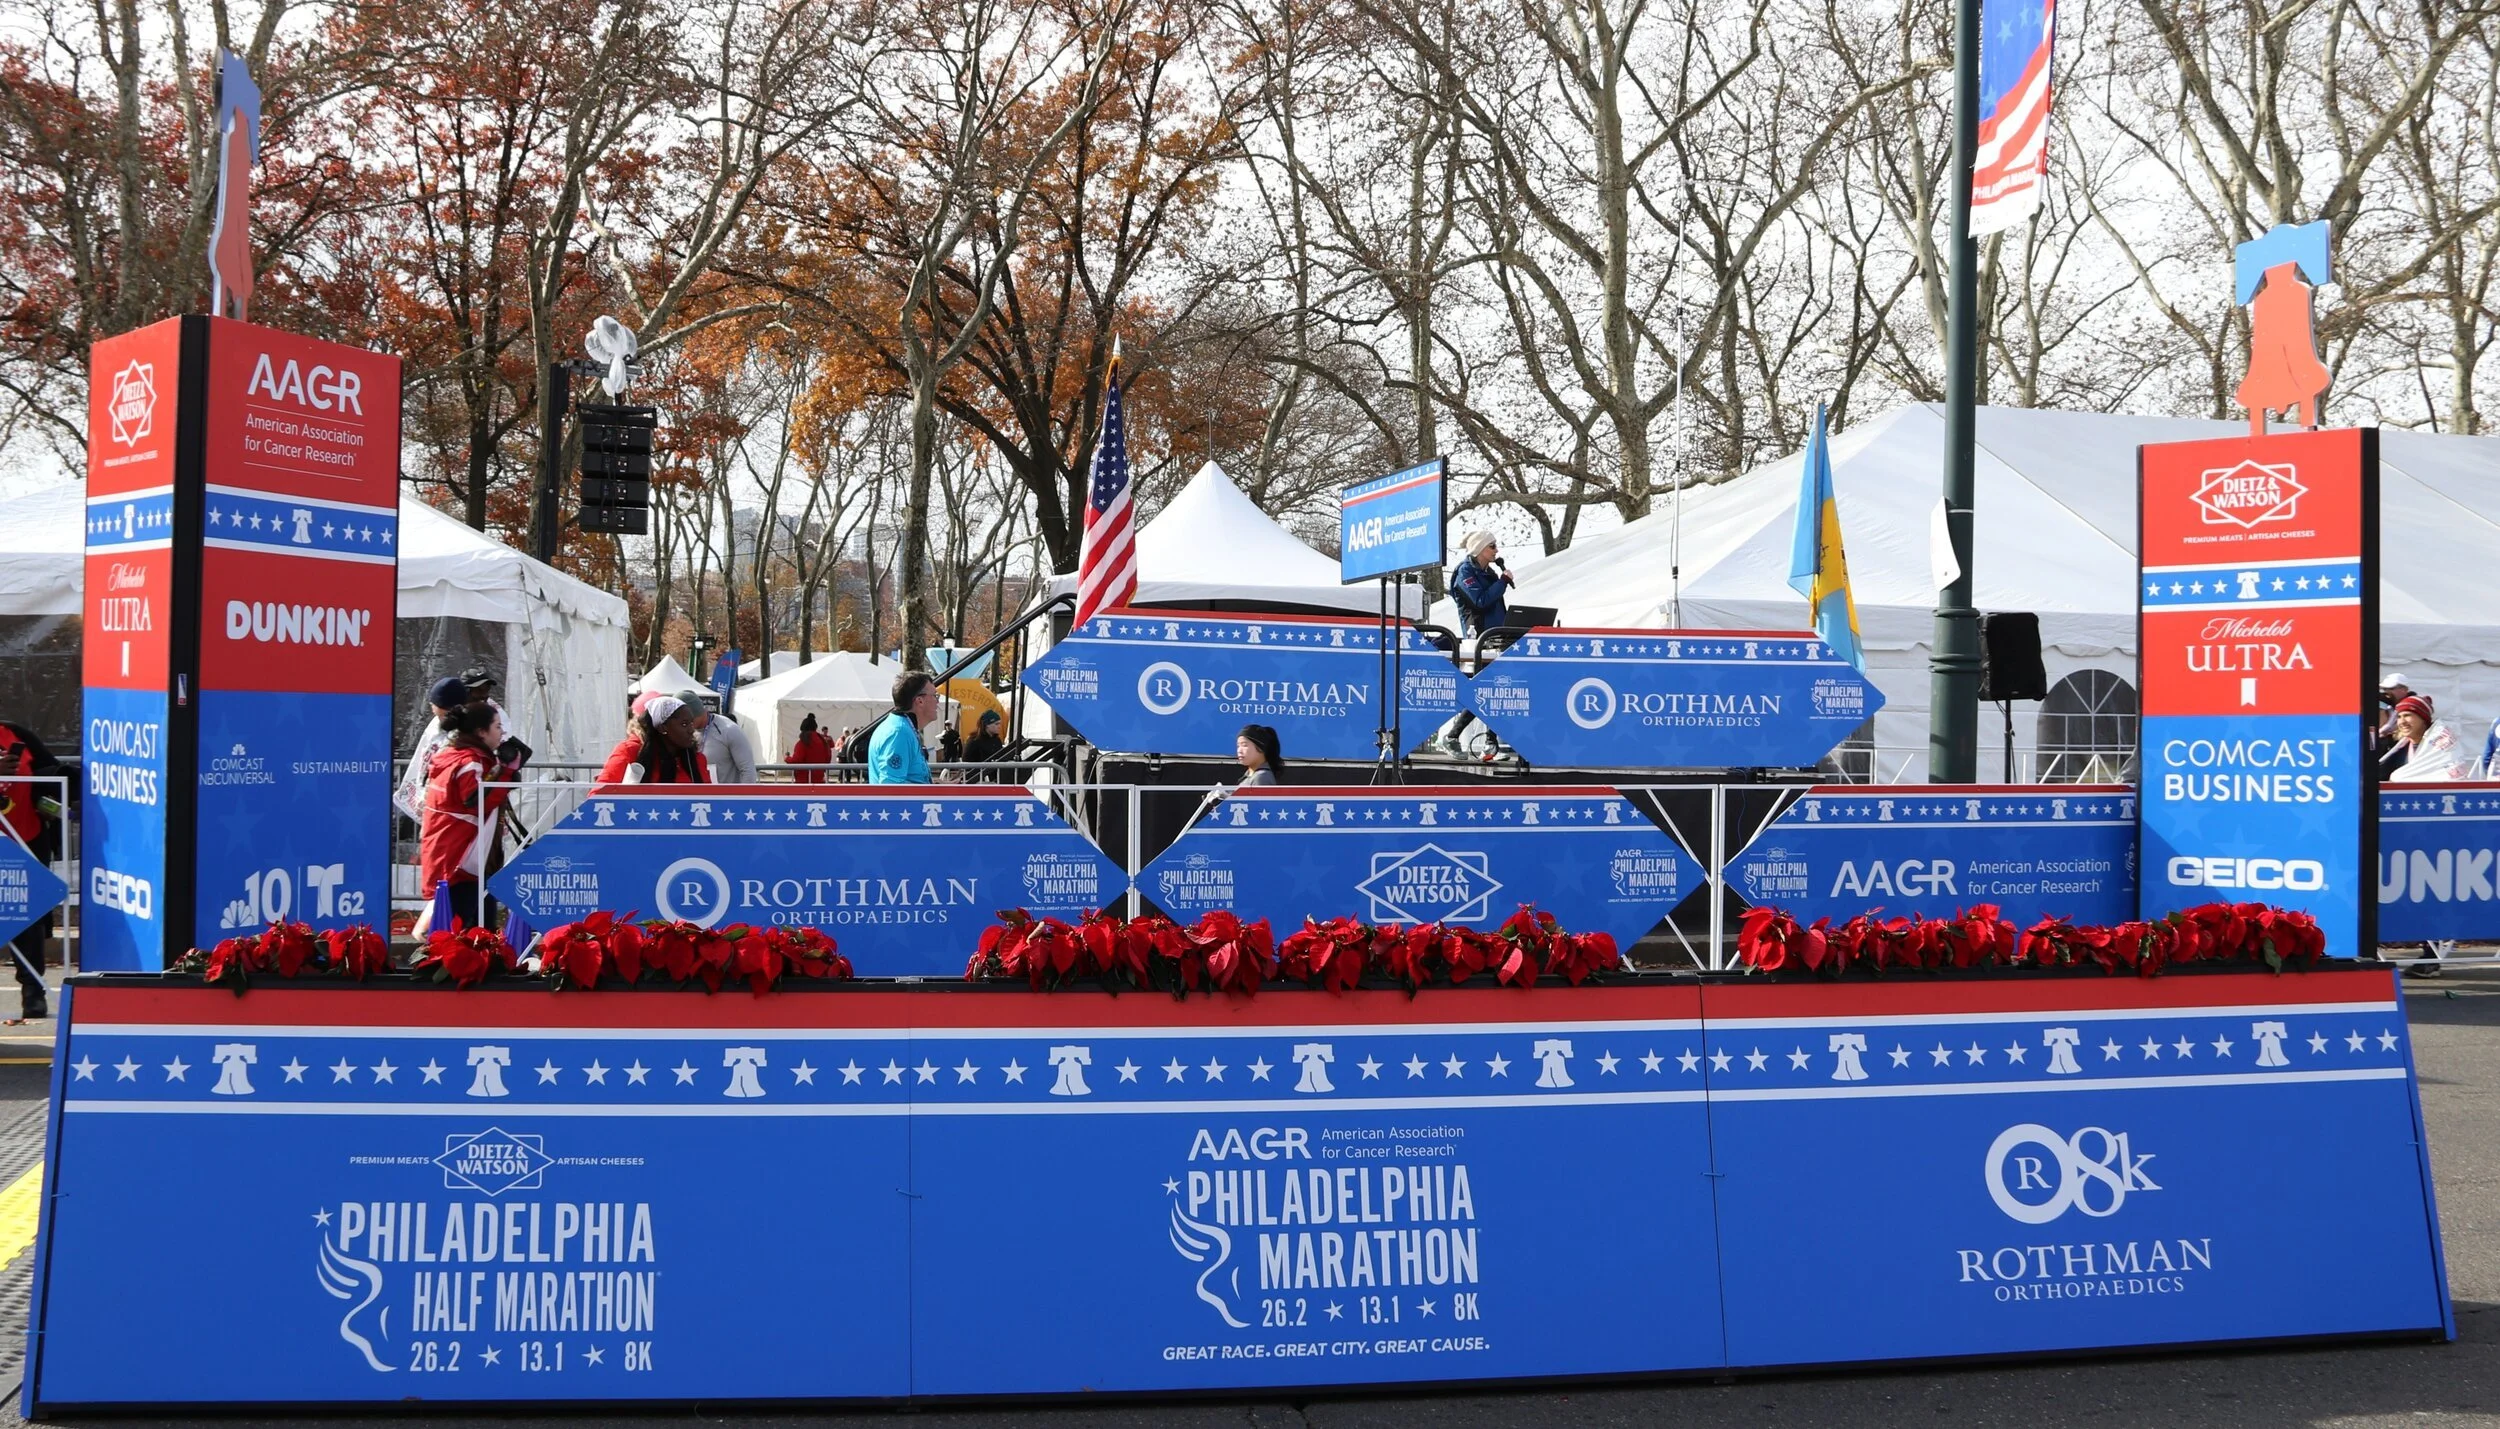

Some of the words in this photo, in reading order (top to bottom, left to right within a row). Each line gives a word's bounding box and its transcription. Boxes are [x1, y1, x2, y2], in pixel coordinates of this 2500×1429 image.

[247, 353, 364, 417] AACR
[245, 413, 299, 437] American
[302, 423, 364, 447] Association
[244, 435, 260, 452] for
[264, 439, 302, 459] Cancer
[305, 445, 356, 466] Research
[2223, 477, 2266, 493] DIETZ
[2267, 477, 2280, 490] &
[2212, 491, 2280, 508] WATSON
[1348, 517, 1383, 552] AACR
[2183, 536, 2217, 544] PREMIUM
[2219, 534, 2243, 542] MEATS
[2248, 533, 2279, 541] ARTISAN
[2281, 530, 2315, 539] CHEESES
[101, 597, 152, 632] ULTRA
[226, 600, 370, 647] DUNKIN'
[2201, 617, 2295, 641] Michelob
[2185, 642, 2313, 672] ULTRA
[1043, 669, 1098, 682] PHILADELPHIA
[1405, 669, 1428, 677] AACR
[1155, 679, 1175, 697] R
[1197, 679, 1369, 705] ROTHMAN
[1405, 677, 1456, 689] PHILADELPHIA
[1814, 687, 1863, 697] PHILADELPHIA
[1416, 689, 1456, 700] MARATHON
[1478, 688, 1529, 699] PHILADELPHIA
[1219, 703, 1346, 717] ORTHOPAEDICS
[1584, 694, 1601, 712] R
[1622, 694, 1781, 715] ROTHMAN
[1826, 698, 1863, 708] MARATHON
[1643, 716, 1761, 727] ORTHOPAEDICS
[90, 718, 159, 760] COMCAST
[2163, 739, 2335, 768] COMCAST
[211, 758, 265, 771] COMCAST
[292, 761, 388, 774] SUSTAINABILITY
[91, 762, 157, 806] BUSINESS
[199, 772, 276, 786] NBCUNIVERSAL
[2164, 774, 2334, 803] BUSINESS
[1027, 854, 1058, 863] AACR
[1615, 849, 1642, 858] AACR
[1027, 864, 1097, 879] PHILADELPHIA
[1614, 858, 1677, 873] PHILADELPHIA
[1747, 863, 1808, 876] PHILADELPHIA
[1969, 861, 2032, 875] American
[2036, 859, 2111, 874] Association
[2167, 857, 2324, 891] GEICO
[520, 874, 599, 889] PHILADELPHIA
[1163, 870, 1233, 885] PHILADELPHIA
[1399, 866, 1451, 884] DIETZ
[1455, 868, 1469, 883] &
[1629, 873, 1677, 887] MARATHON
[1761, 878, 1776, 891] HALF
[1777, 877, 1808, 890] MARATHON
[1830, 860, 1958, 898] AACR
[2378, 849, 2500, 904] UNK
[92, 867, 151, 920] GEICO
[680, 882, 708, 906] R
[739, 878, 977, 907] ROTHMAN
[1044, 880, 1098, 894] MARATHON
[1180, 886, 1196, 900] HALF
[1198, 886, 1234, 900] MARATHON
[1384, 884, 1470, 904] WATSON
[1968, 881, 1988, 895] for
[1991, 880, 2038, 894] Cancer
[2041, 879, 2100, 894] Research
[244, 868, 292, 926] 10
[338, 891, 365, 917] 62
[538, 891, 557, 905] HALF
[559, 891, 599, 906] MARATHON
[771, 910, 948, 925] ORTHOPAEDICS
[468, 1144, 513, 1159] DIETZ
[515, 1146, 528, 1159] &
[1187, 1127, 1312, 1161] AACR
[1321, 1128, 1385, 1141] American
[1389, 1126, 1465, 1139] Association
[1322, 1146, 1340, 1159] for
[1344, 1146, 1390, 1158] Cancer
[1395, 1144, 1455, 1157] Research
[350, 1156, 395, 1164] PREMIUM
[397, 1157, 430, 1165] MEATS
[456, 1160, 529, 1175] WATSON
[557, 1157, 598, 1165] ARTISAN
[600, 1157, 644, 1166] CHEESES
[2014, 1156, 2052, 1190] R
[1187, 1165, 1475, 1226] PHILADELPHIA
[339, 1202, 655, 1262] PHILADELPHIA
[1259, 1228, 1478, 1290] MARATHON
[1956, 1238, 2212, 1282] ROTHMAN
[1994, 1276, 2184, 1302] ORTHOPAEDICS
[413, 1272, 485, 1331] HALF
[495, 1271, 655, 1332] MARATHON
[1262, 1299, 1307, 1328] 26.2
[1360, 1296, 1400, 1325] 13.1
[1454, 1293, 1480, 1321] 8K
[410, 1342, 461, 1372] 26.2
[519, 1342, 563, 1372] 13.1
[624, 1342, 653, 1372] 8K
[1163, 1347, 1219, 1361] GREAT
[1221, 1345, 1271, 1359] RACE.
[1274, 1343, 1328, 1358] GREAT
[1331, 1341, 1371, 1356] CITY.
[1374, 1339, 1427, 1354] GREAT
[1431, 1337, 1491, 1352] CAUSE.
